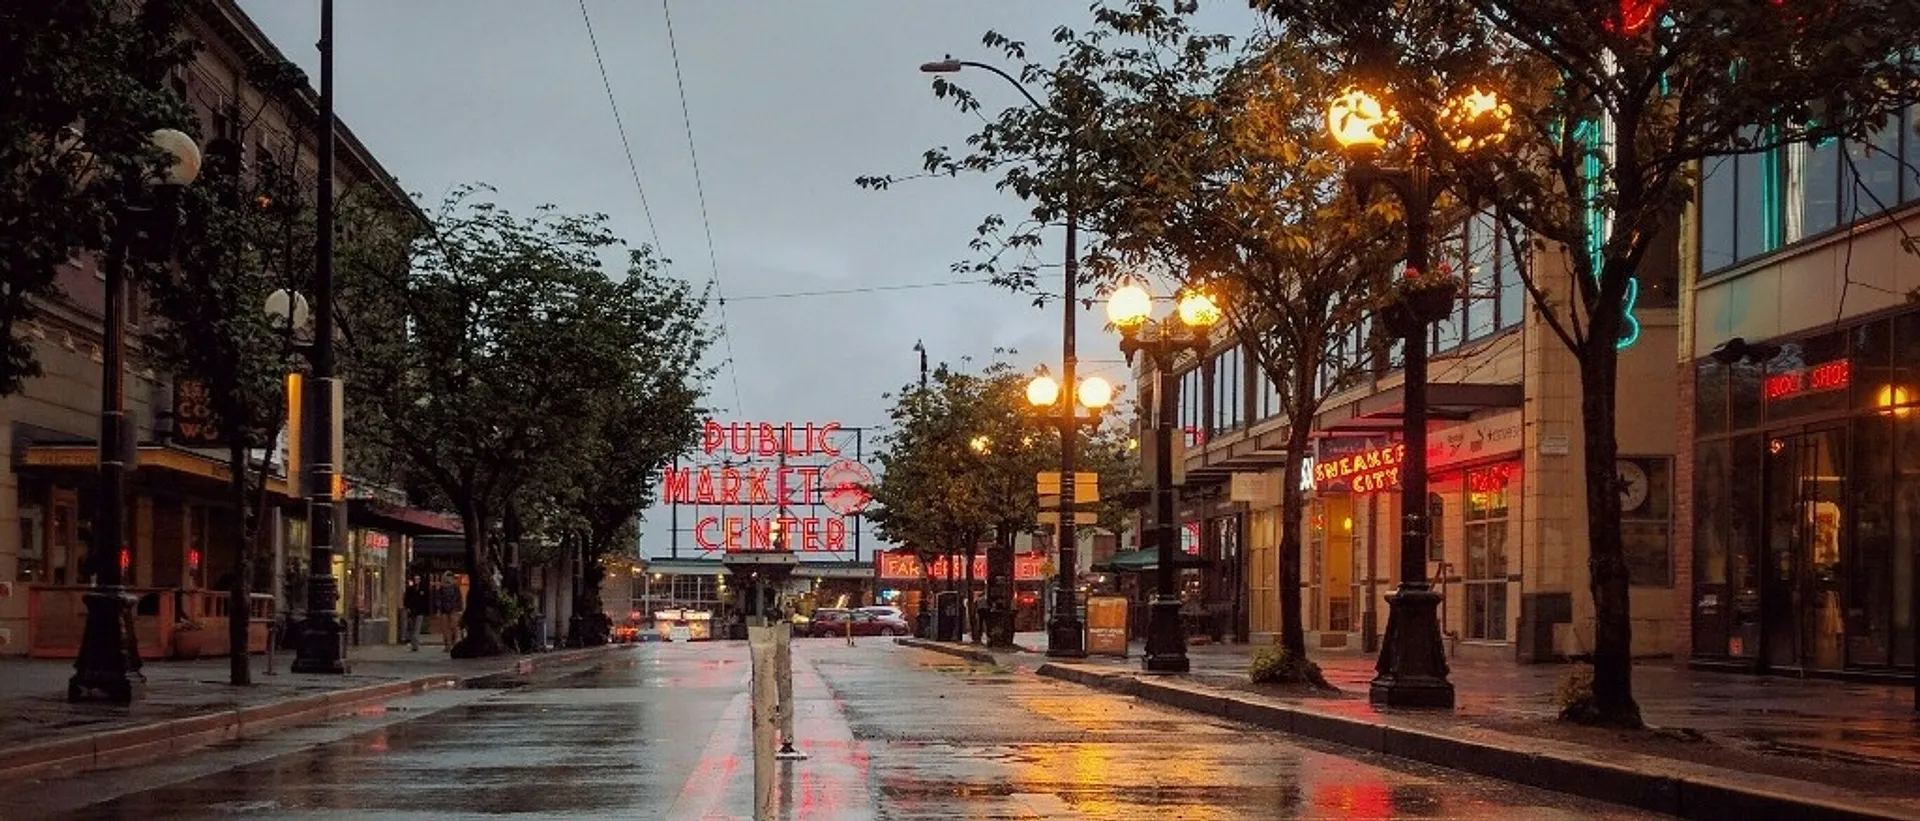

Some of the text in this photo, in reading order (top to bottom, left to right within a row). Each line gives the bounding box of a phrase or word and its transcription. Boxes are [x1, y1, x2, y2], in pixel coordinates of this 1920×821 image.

[703, 421, 842, 456] PUBLIC
[664, 465, 820, 505] MARKET
[1352, 467, 1399, 493] CITY
[695, 516, 846, 554] CENTER
